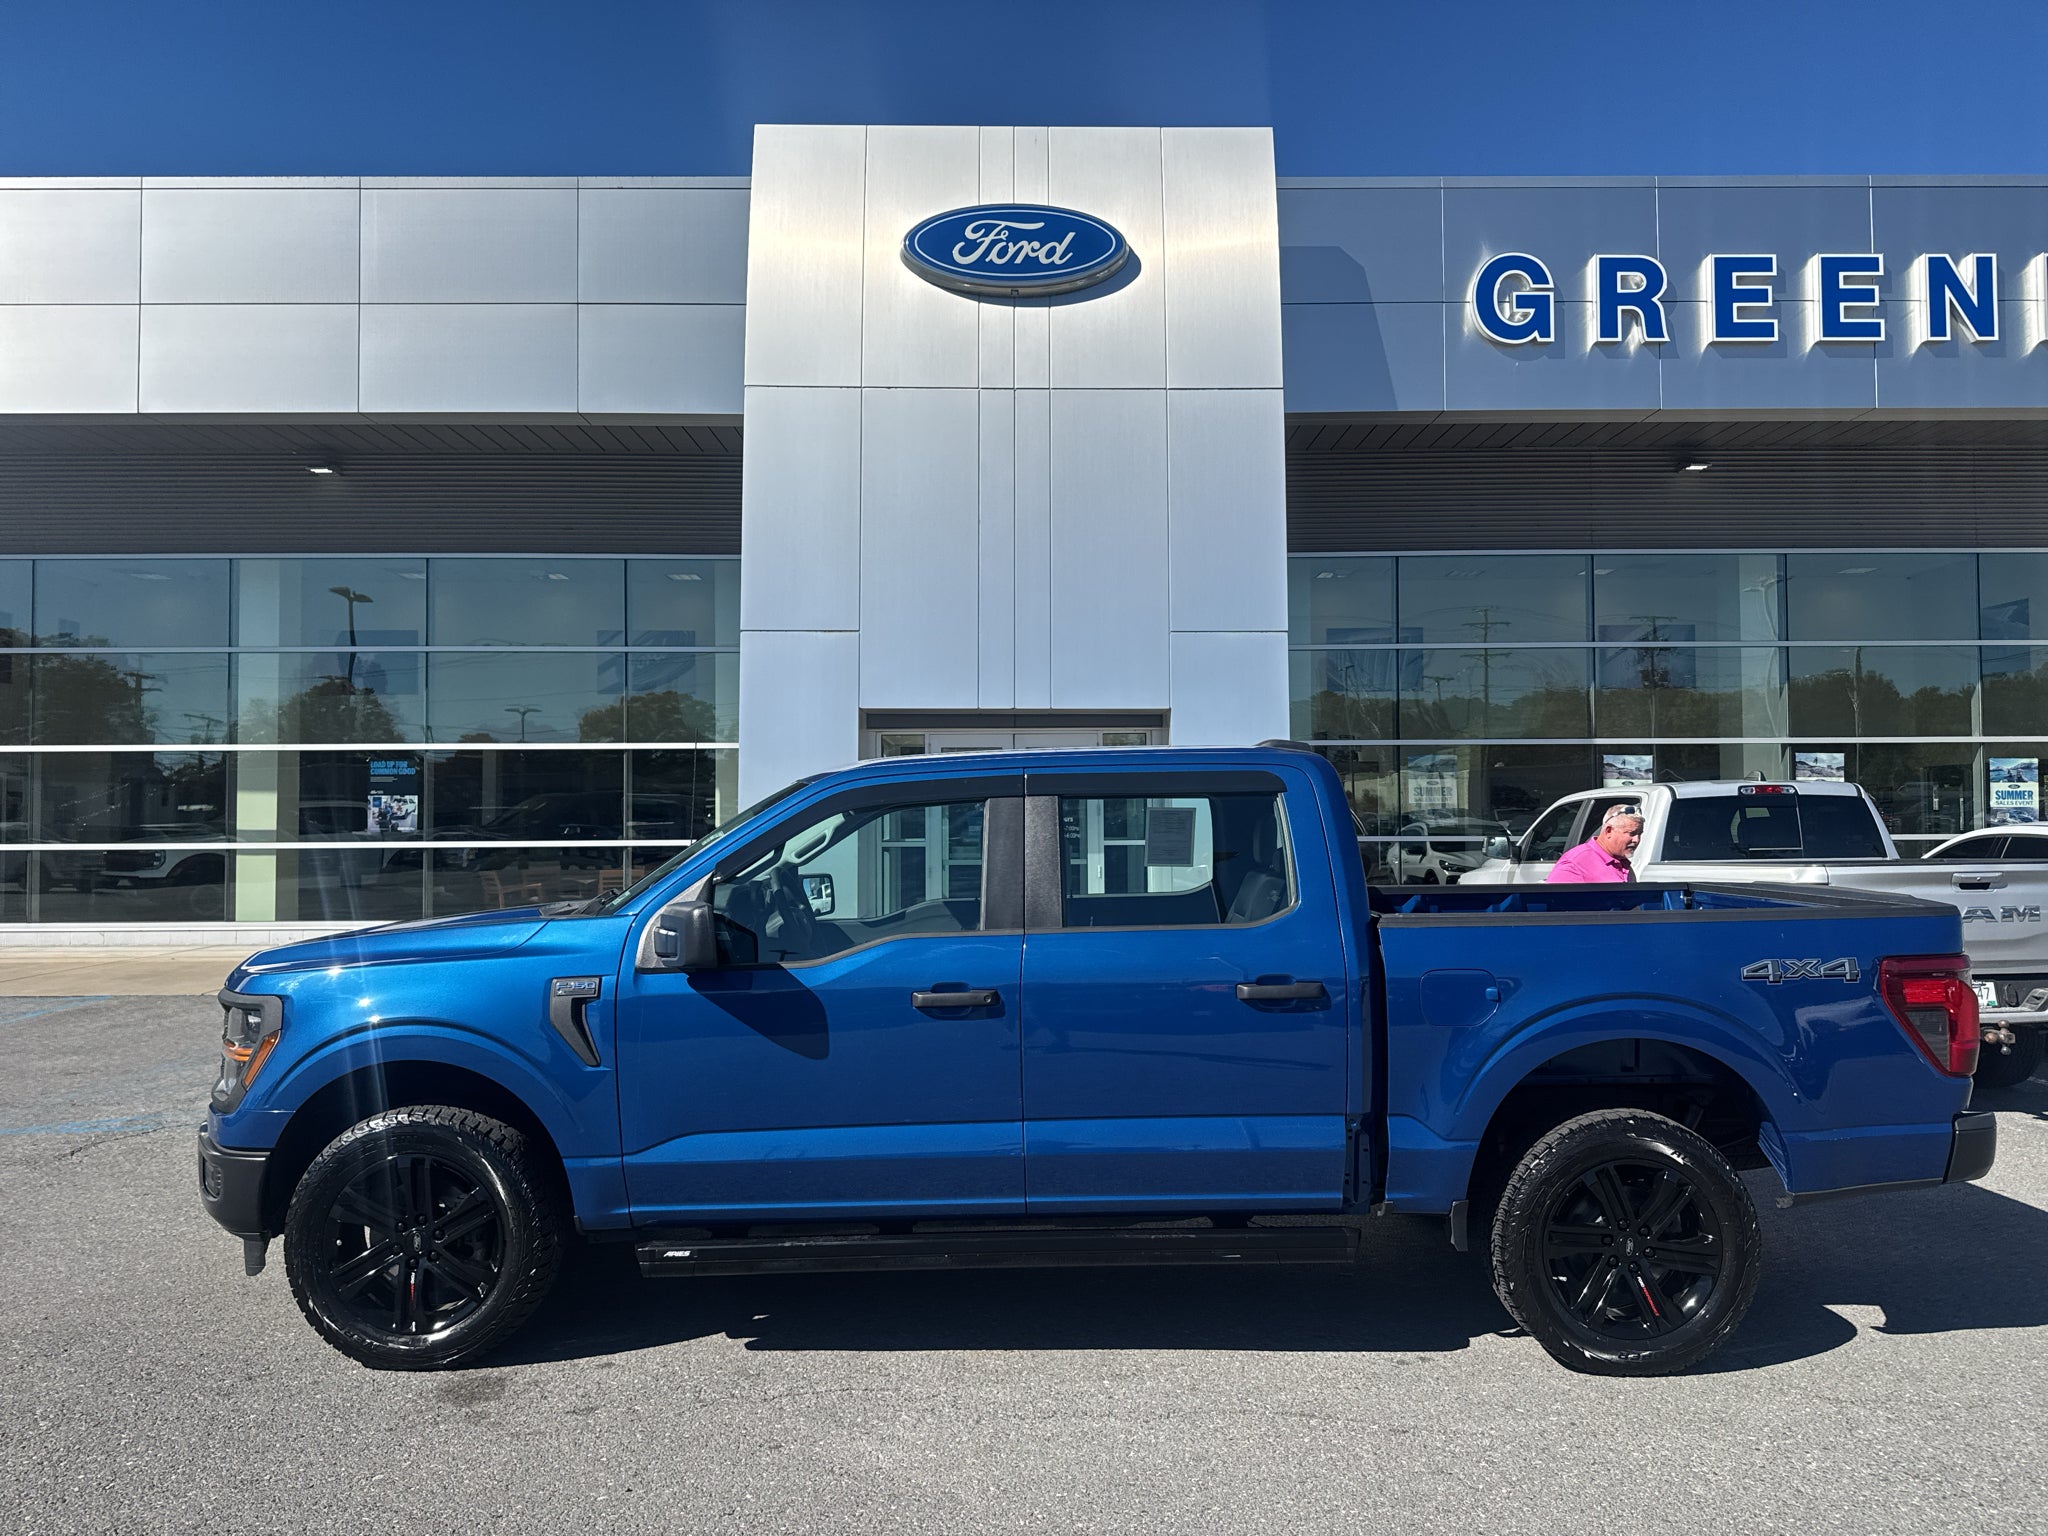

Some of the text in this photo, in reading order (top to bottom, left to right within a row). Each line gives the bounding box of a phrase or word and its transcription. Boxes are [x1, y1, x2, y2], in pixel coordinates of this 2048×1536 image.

[952, 219, 1076, 265] Ford
[1471, 251, 2048, 345] GREEN
[1995, 790, 2034, 801] SUMMER
[1961, 905, 2041, 923] AM
[555, 981, 596, 991] F-150
